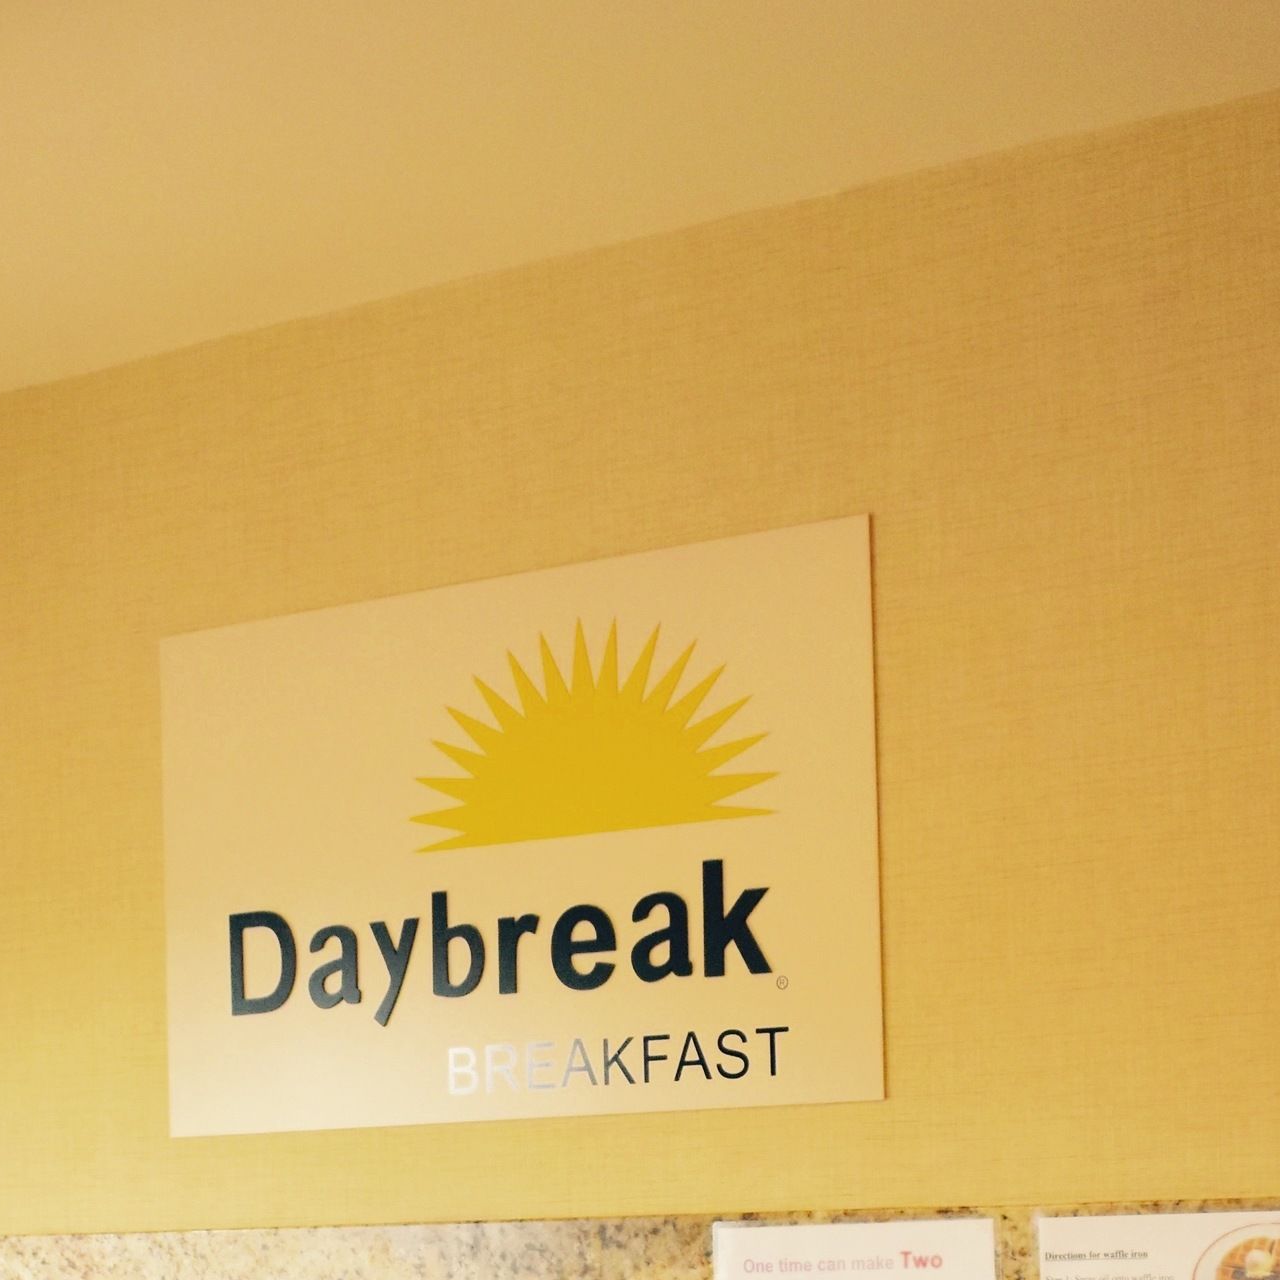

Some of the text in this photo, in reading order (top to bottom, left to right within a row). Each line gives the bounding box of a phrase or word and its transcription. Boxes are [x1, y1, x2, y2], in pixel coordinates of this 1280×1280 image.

[228, 859, 772, 1027] Daybreak
[447, 1026, 790, 1095] BREAKFAST
[743, 1251, 943, 1274] One time can make Two
[1045, 1250, 1148, 1261] Directions for waffle iron
